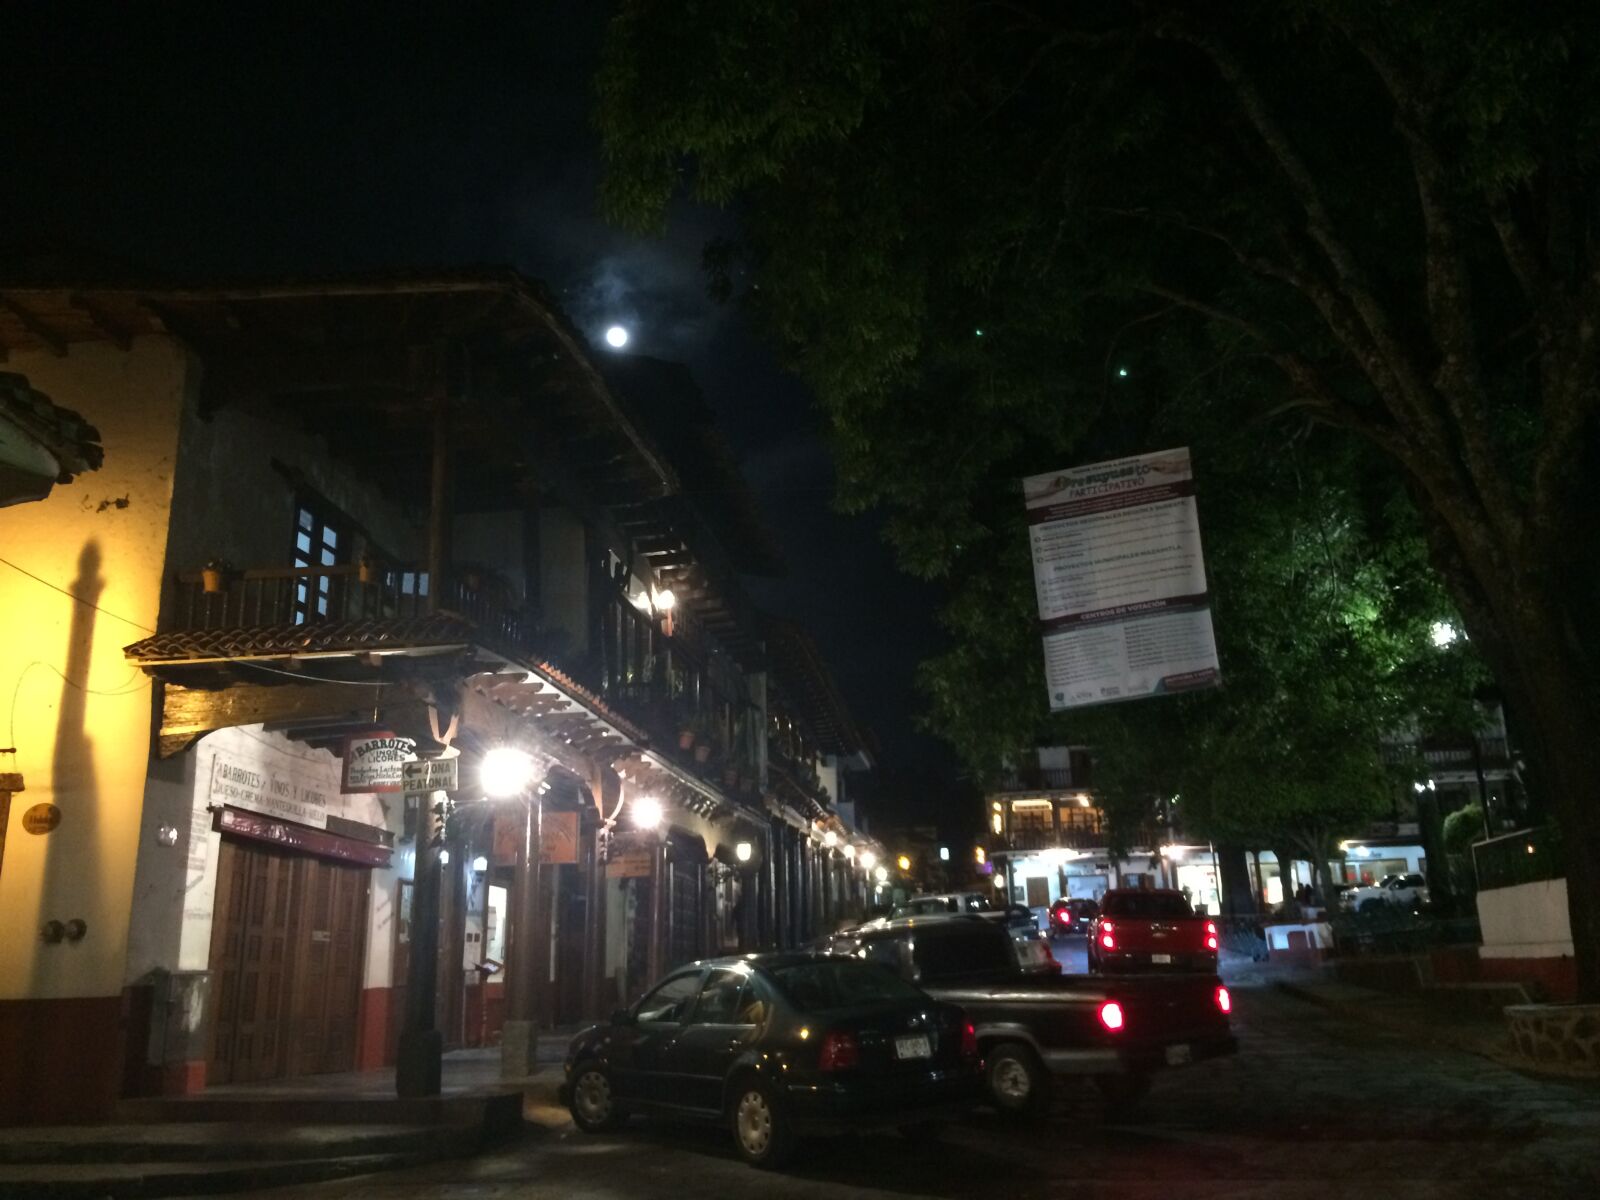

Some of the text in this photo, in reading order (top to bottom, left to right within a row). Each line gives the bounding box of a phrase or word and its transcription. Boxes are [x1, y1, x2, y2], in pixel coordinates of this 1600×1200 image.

[1069, 477, 1145, 498] PARTICIPATIVO
[350, 739, 416, 763] ABARROTES
[368, 754, 405, 763] LICORES
[425, 763, 450, 775] ZONA
[403, 777, 454, 791] PEATONAL
